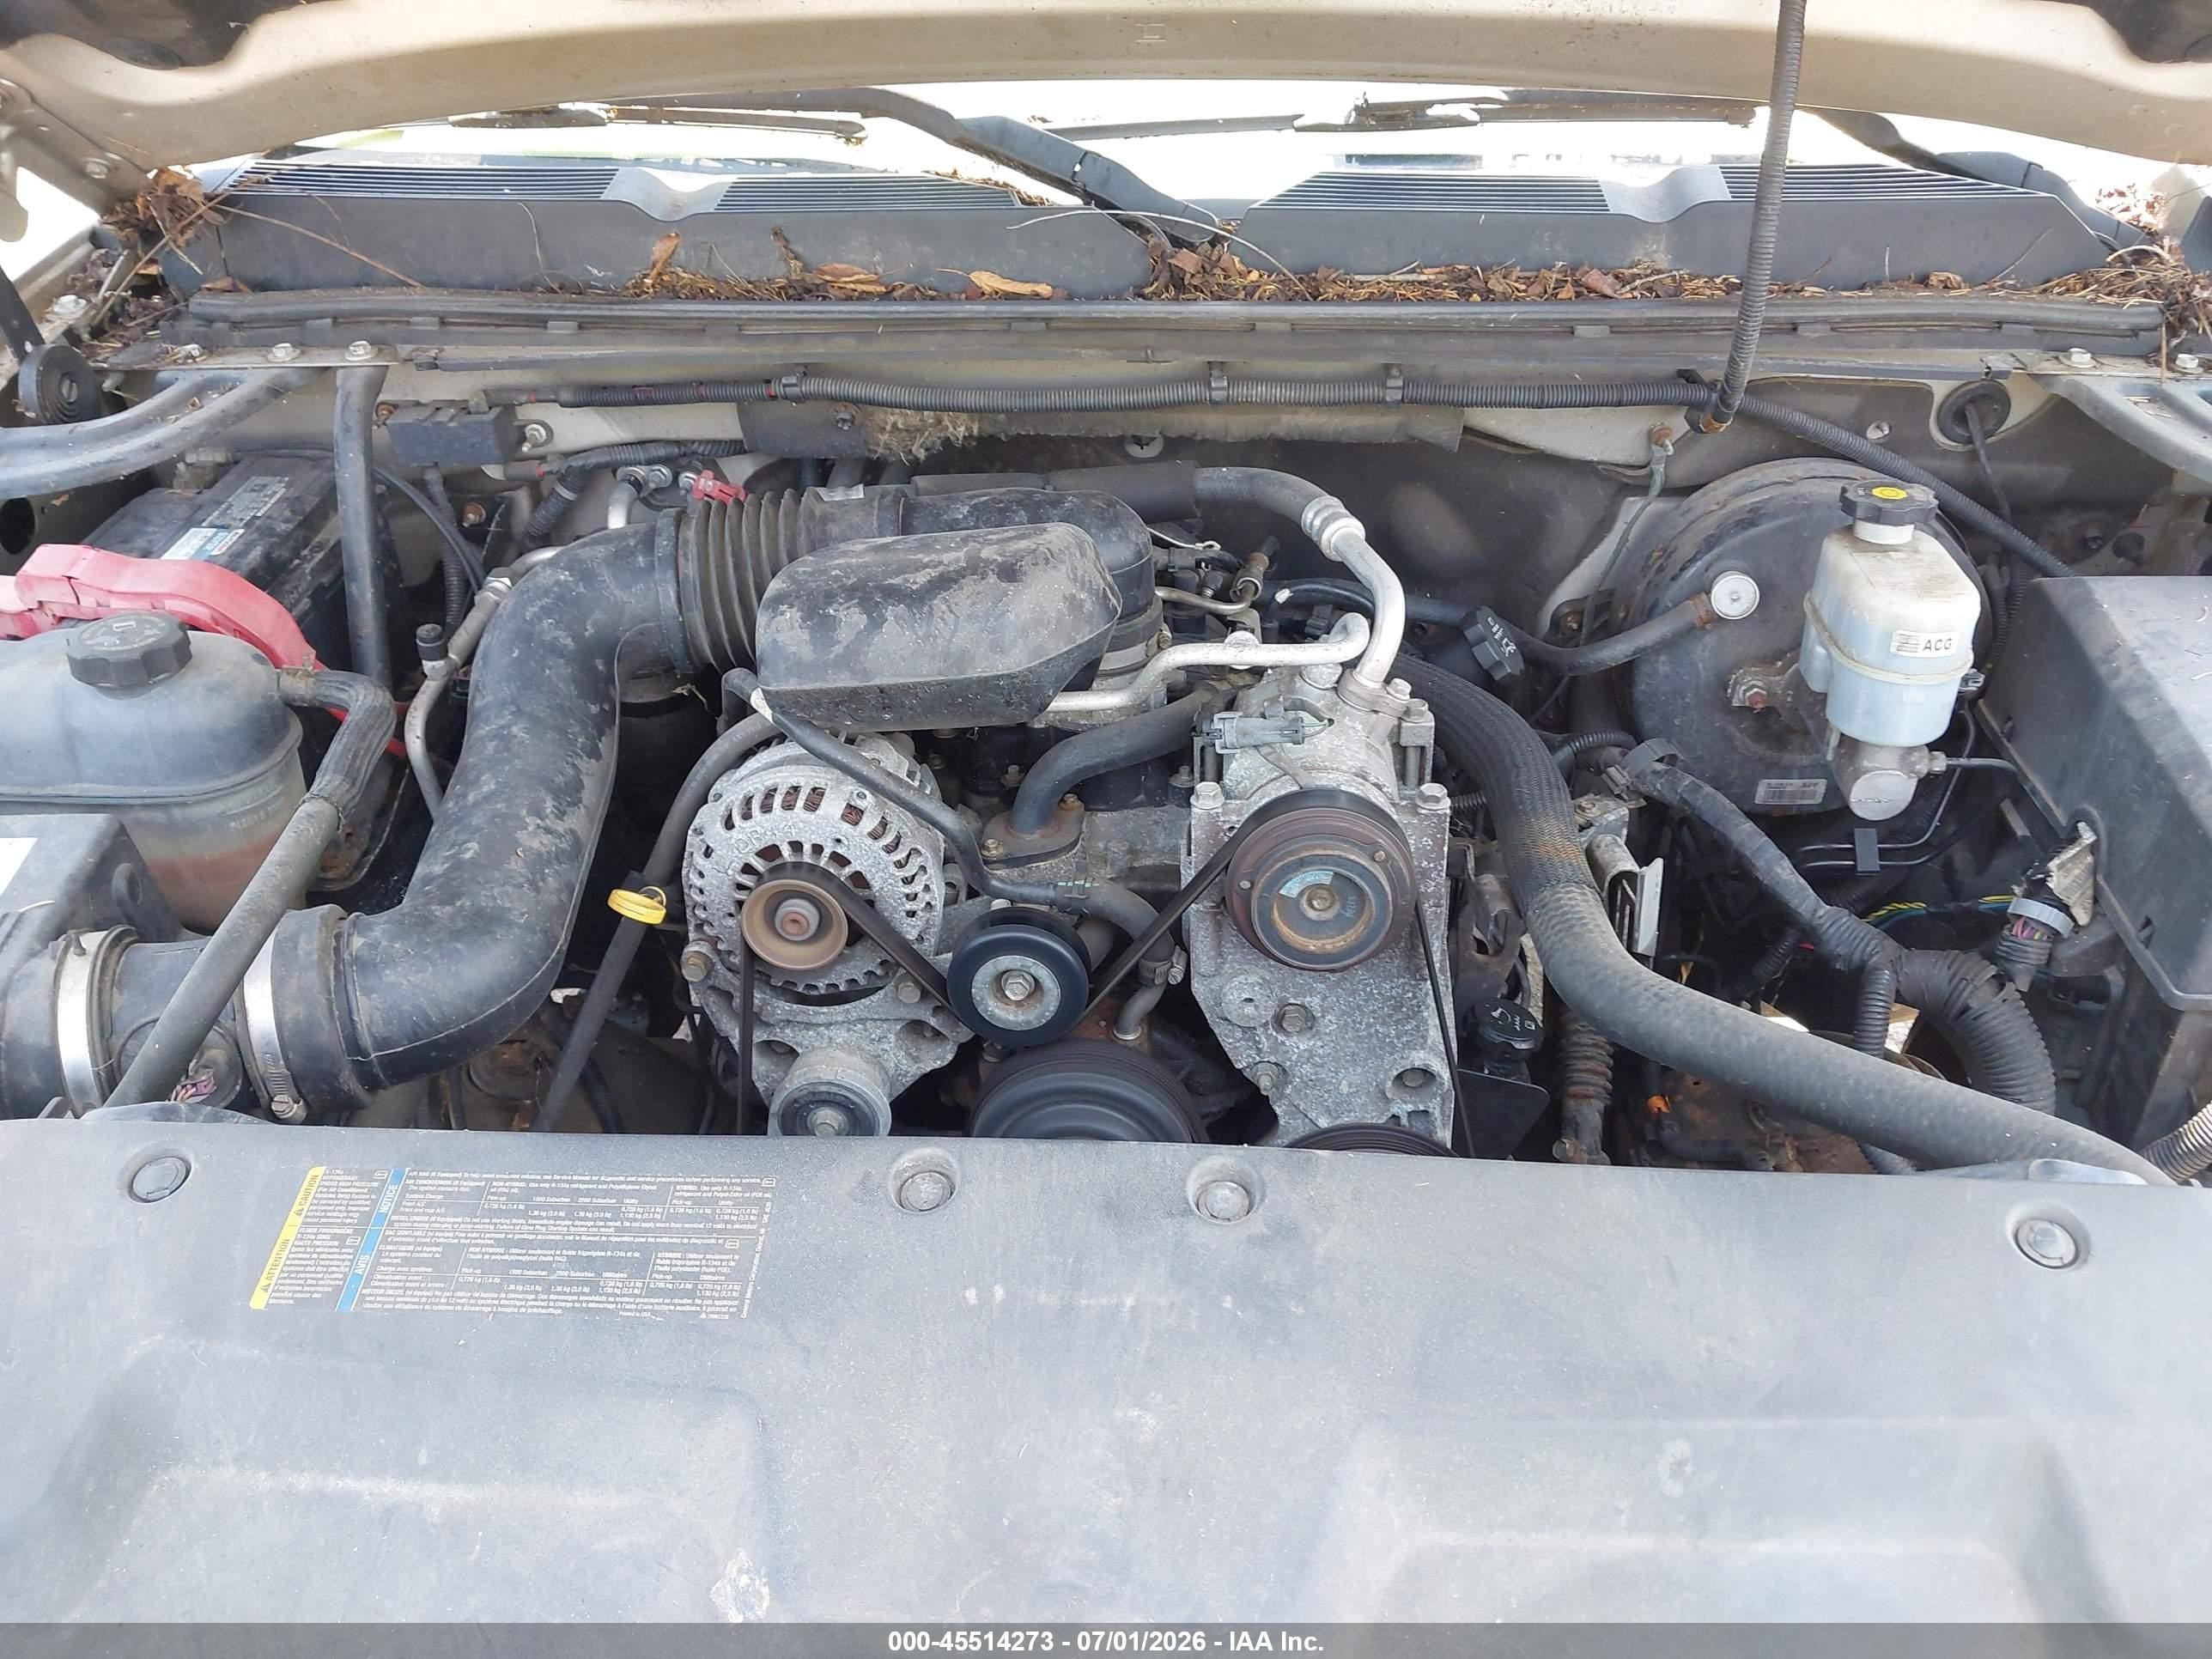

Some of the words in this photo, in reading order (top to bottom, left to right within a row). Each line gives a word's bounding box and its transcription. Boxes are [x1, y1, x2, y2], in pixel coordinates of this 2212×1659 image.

[1922, 637, 1953, 652] ACG
[299, 1174, 319, 1208] CAUTION
[379, 1184, 399, 1213] NOTICE
[266, 1238, 290, 1281] ATTENTION
[354, 1255, 370, 1275] AVIS
